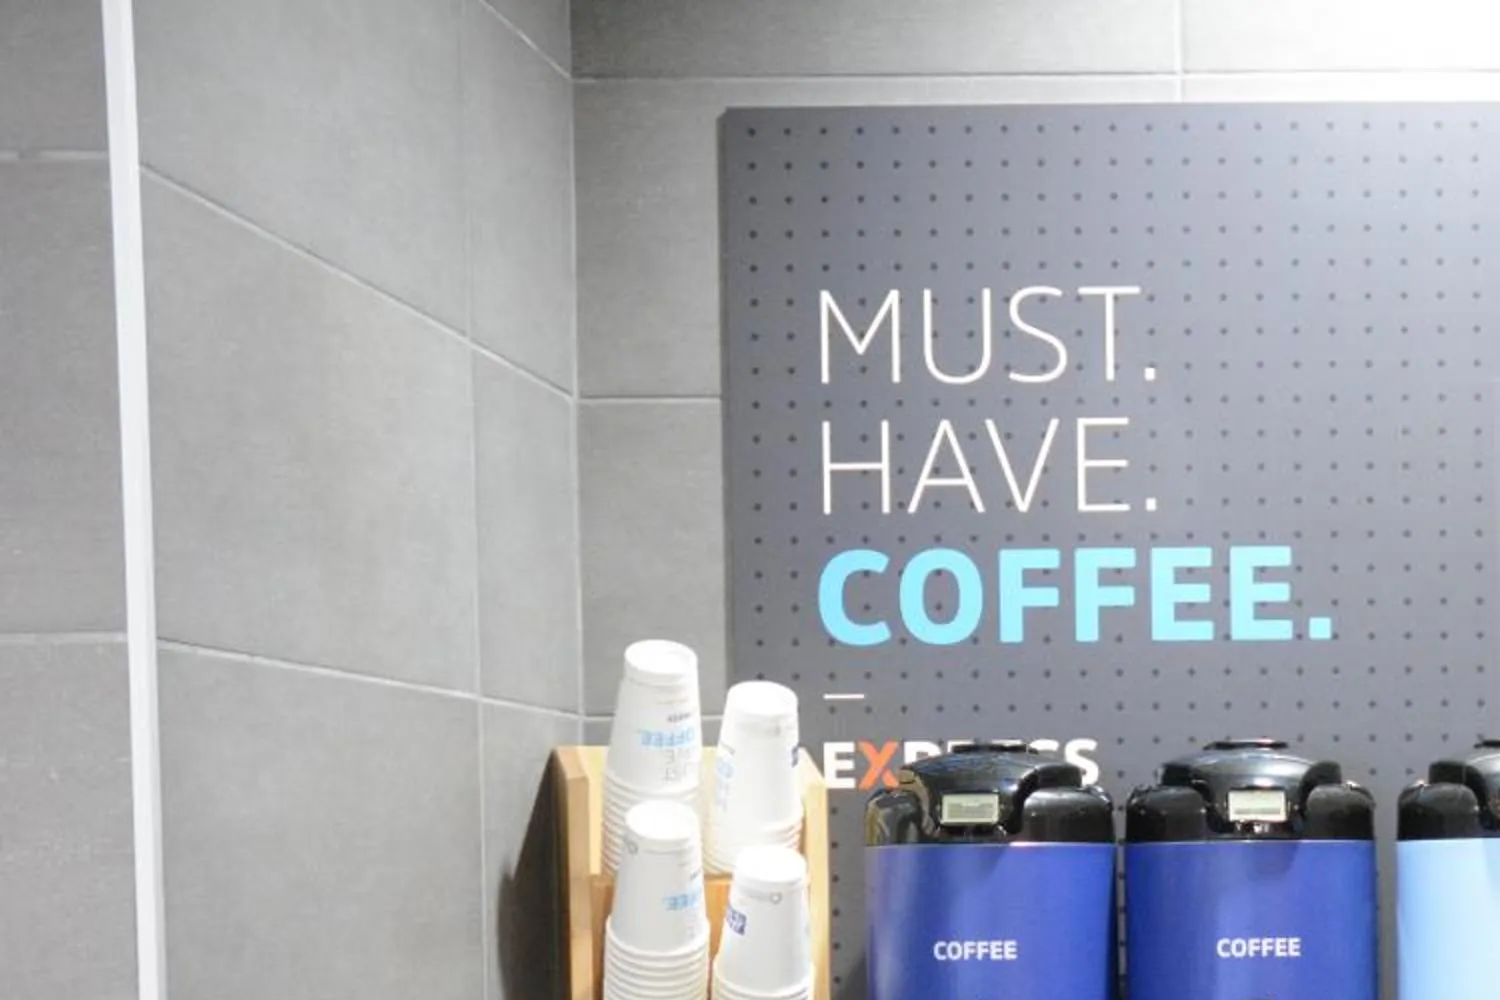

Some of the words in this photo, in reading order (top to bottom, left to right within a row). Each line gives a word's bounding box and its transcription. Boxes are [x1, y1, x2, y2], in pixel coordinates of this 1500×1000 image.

[818, 285, 1157, 385] MUST.
[821, 416, 1158, 515] HAVE.
[817, 545, 1332, 646] COFFEE.
[823, 738, 1100, 790] EXPS
[933, 940, 1018, 961] COFFEE
[1216, 937, 1302, 958] COFFEE
